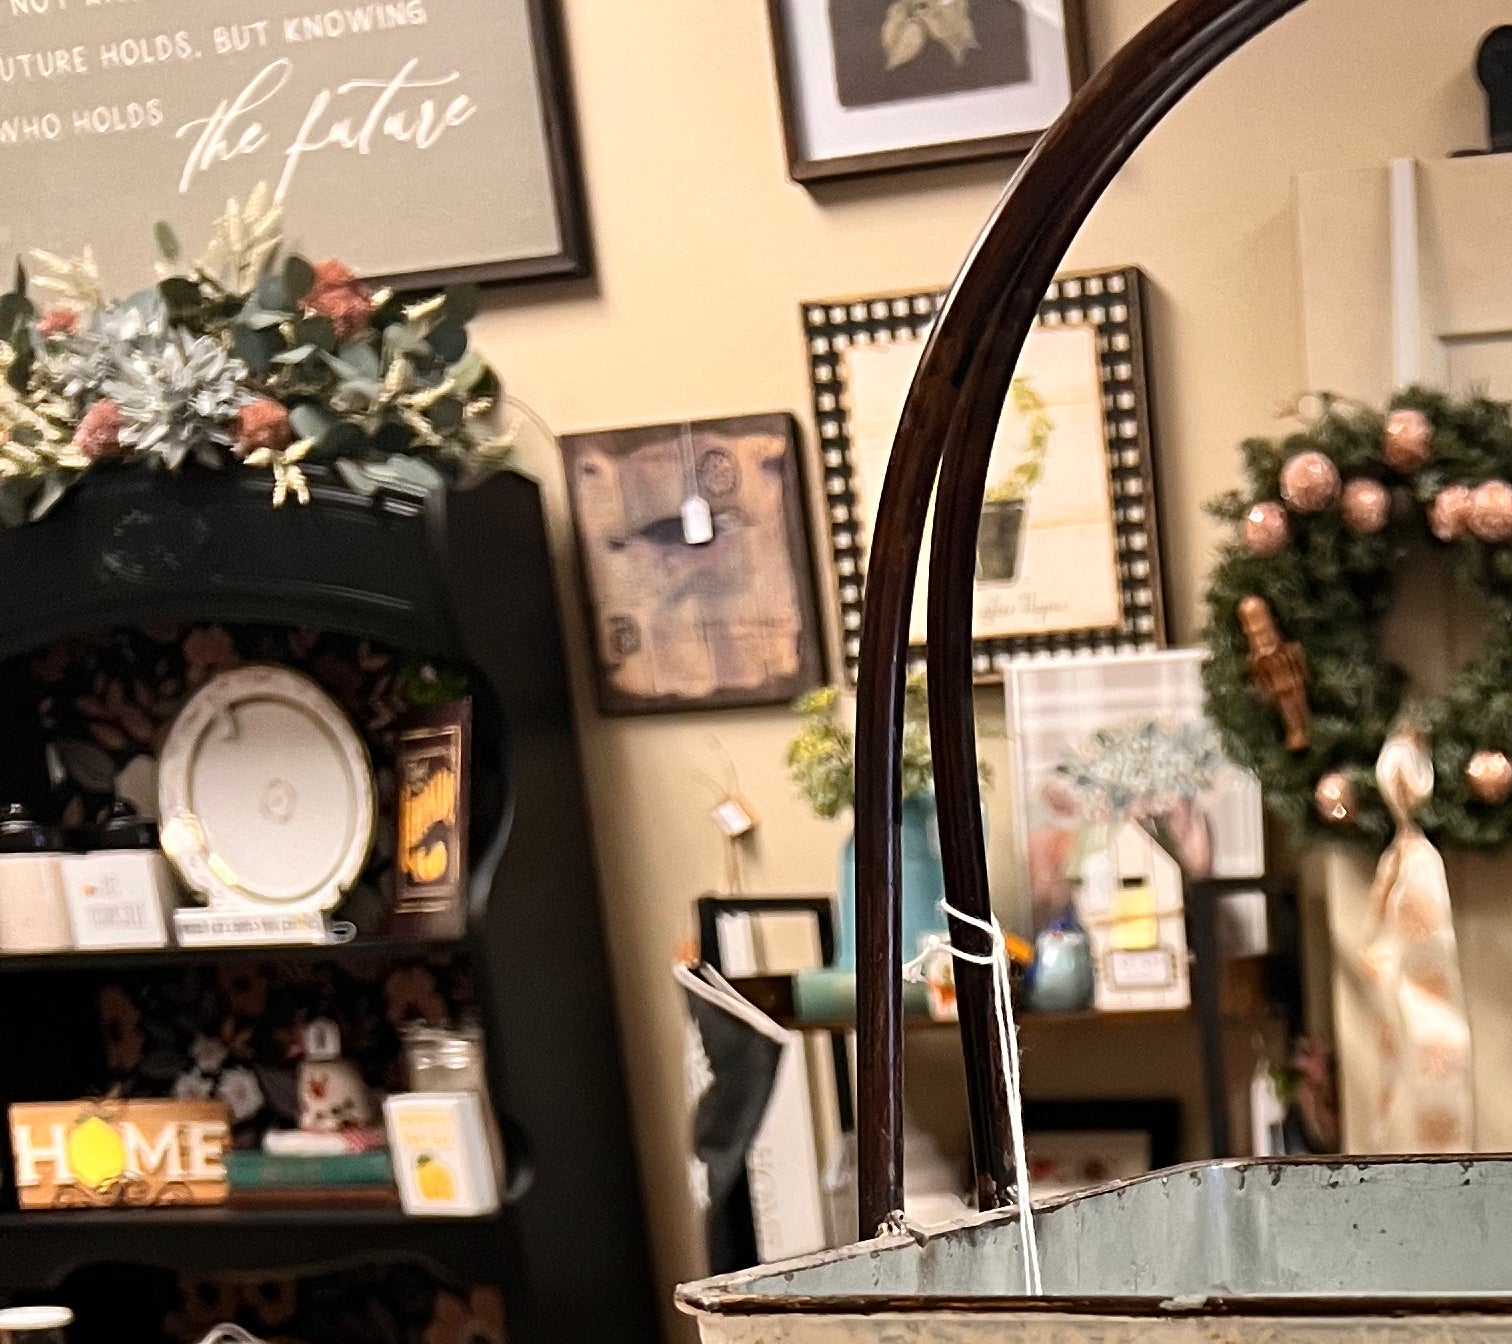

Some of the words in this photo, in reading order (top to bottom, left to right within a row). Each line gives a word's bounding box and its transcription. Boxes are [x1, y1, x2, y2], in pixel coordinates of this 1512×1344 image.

[213, 21, 269, 54] BUT
[283, 0, 428, 44] KNOWING
[72, 98, 163, 133] HOLDS
[176, 57, 293, 192] the
[272, 57, 480, 206] future
